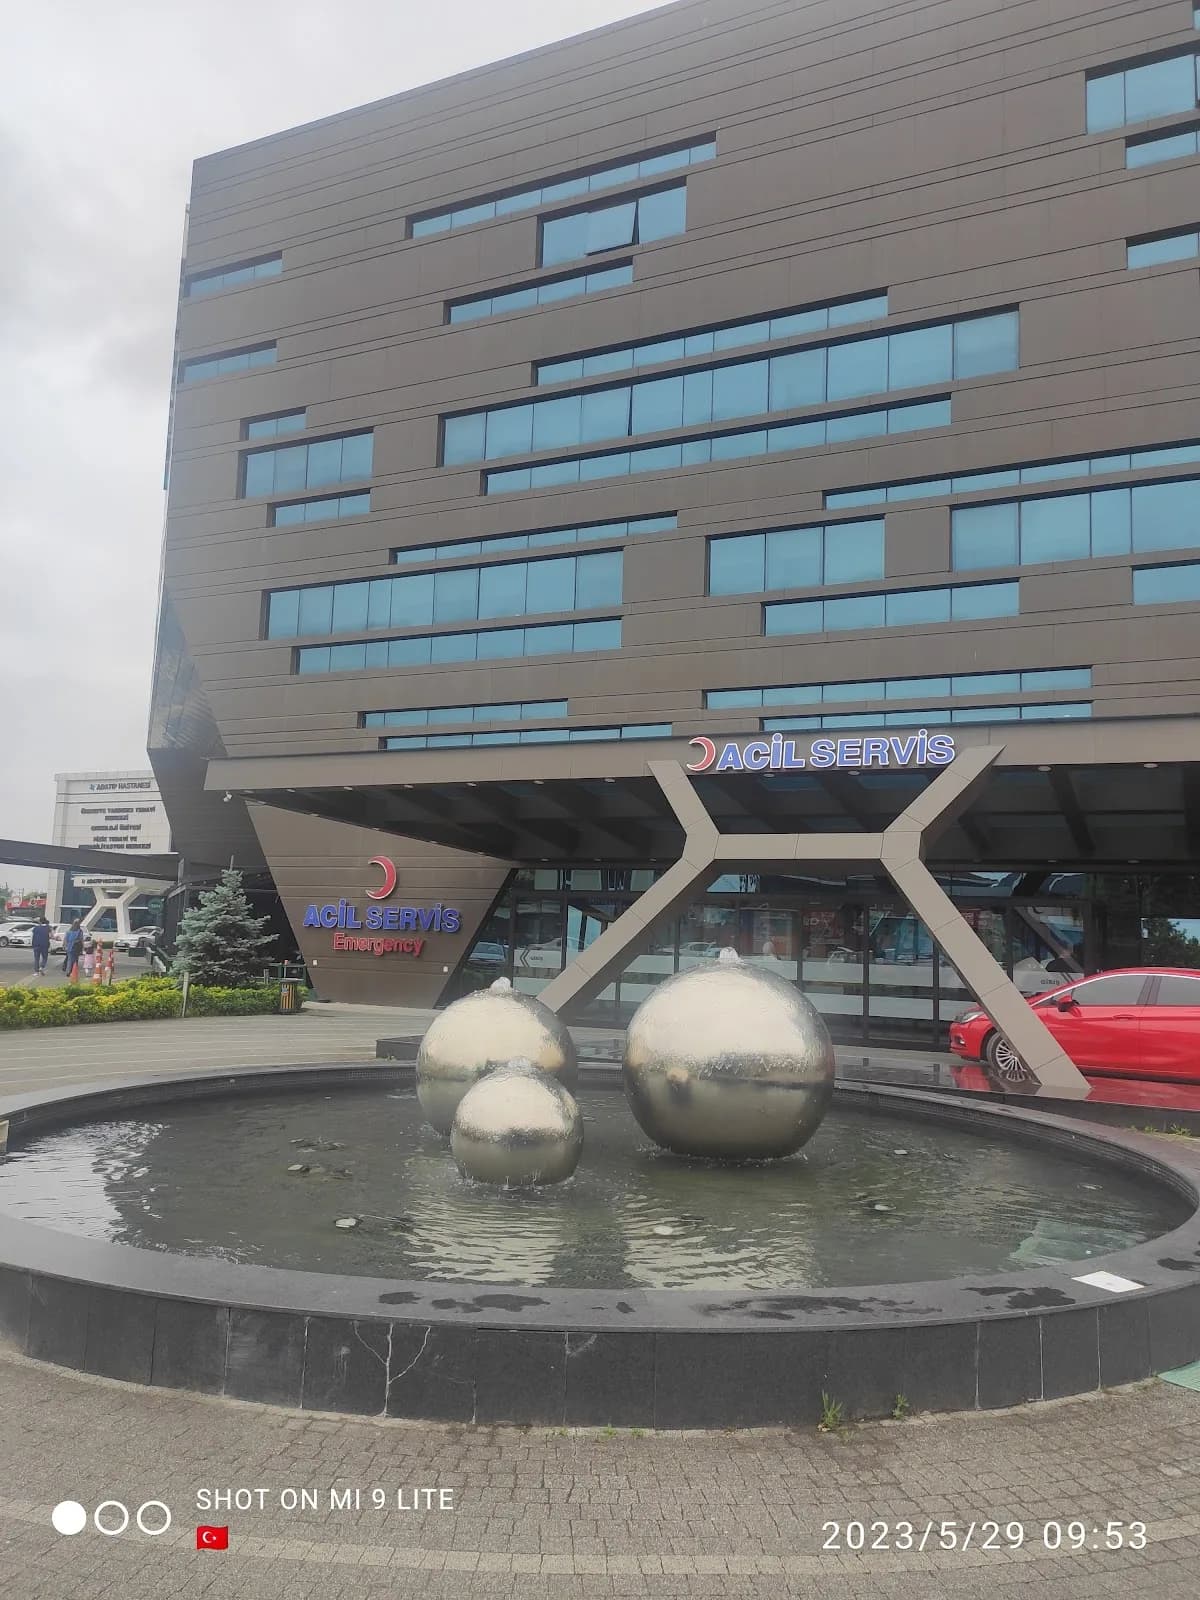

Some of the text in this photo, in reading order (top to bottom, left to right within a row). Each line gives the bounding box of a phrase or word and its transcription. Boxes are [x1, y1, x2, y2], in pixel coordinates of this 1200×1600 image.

[716, 728, 956, 770] ACİL SERVİS
[303, 898, 460, 933] ACİL SERVİS
[333, 932, 424, 957] Emergency
